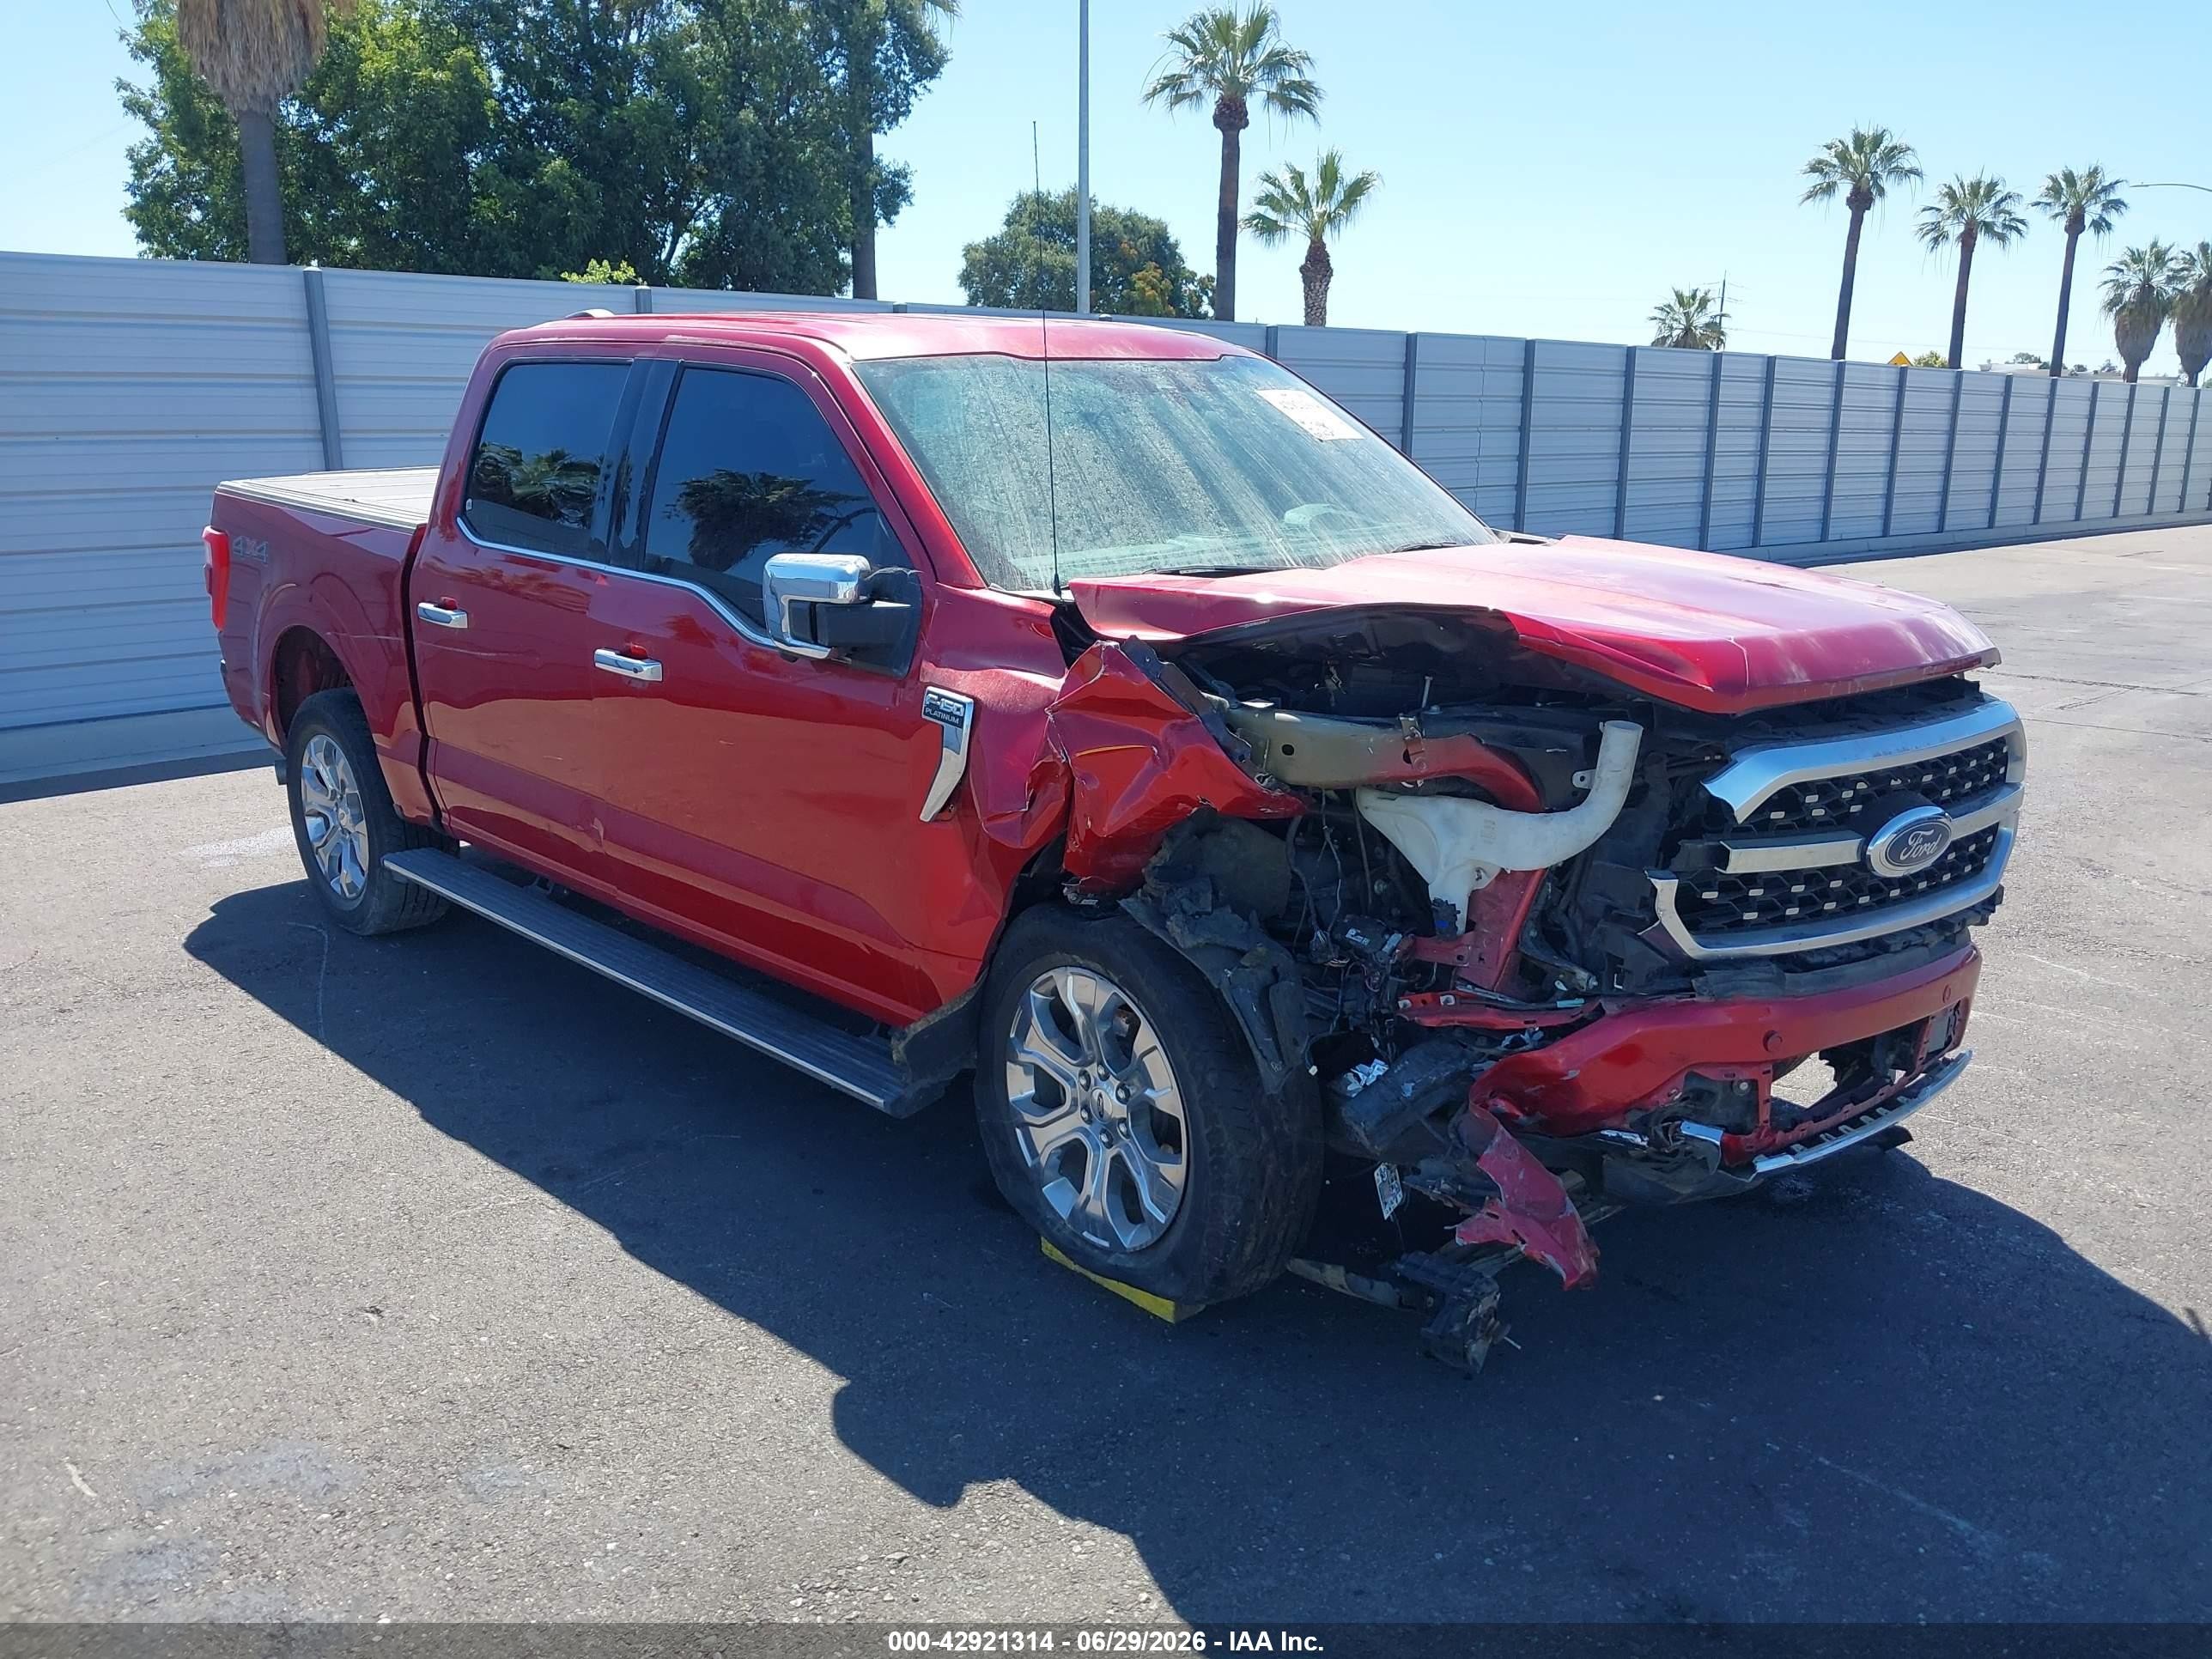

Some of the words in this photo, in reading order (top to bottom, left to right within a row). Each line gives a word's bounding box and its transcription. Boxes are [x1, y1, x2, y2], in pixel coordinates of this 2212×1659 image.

[925, 707, 960, 724] PLATINUM
[926, 693, 964, 716] F-150
[1900, 828, 1942, 860] Ford
